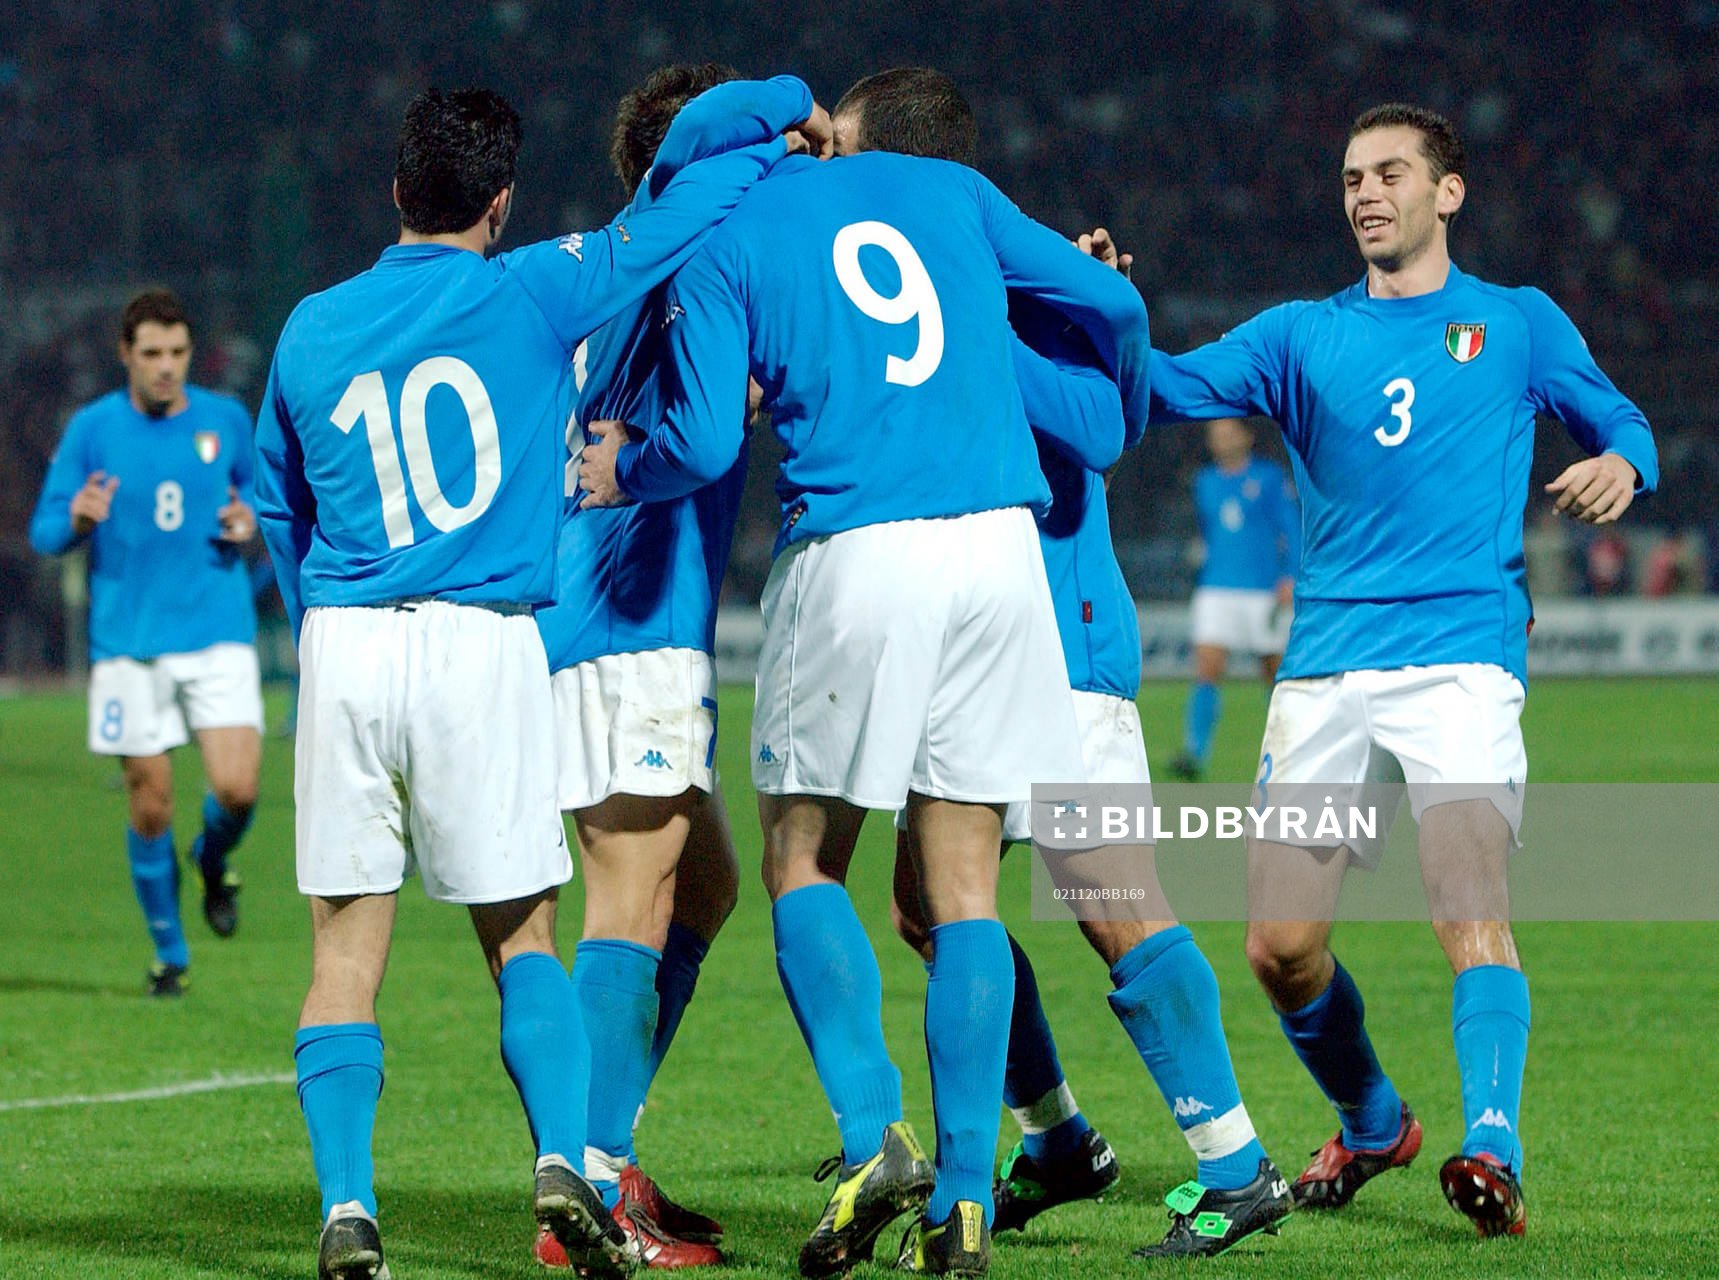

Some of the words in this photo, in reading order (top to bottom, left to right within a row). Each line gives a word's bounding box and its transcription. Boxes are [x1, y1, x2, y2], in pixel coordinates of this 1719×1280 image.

[832, 220, 945, 388] 9
[1373, 377, 1416, 447] 3
[329, 355, 502, 549] 10
[154, 480, 184, 531] 8
[100, 699, 124, 742] 8
